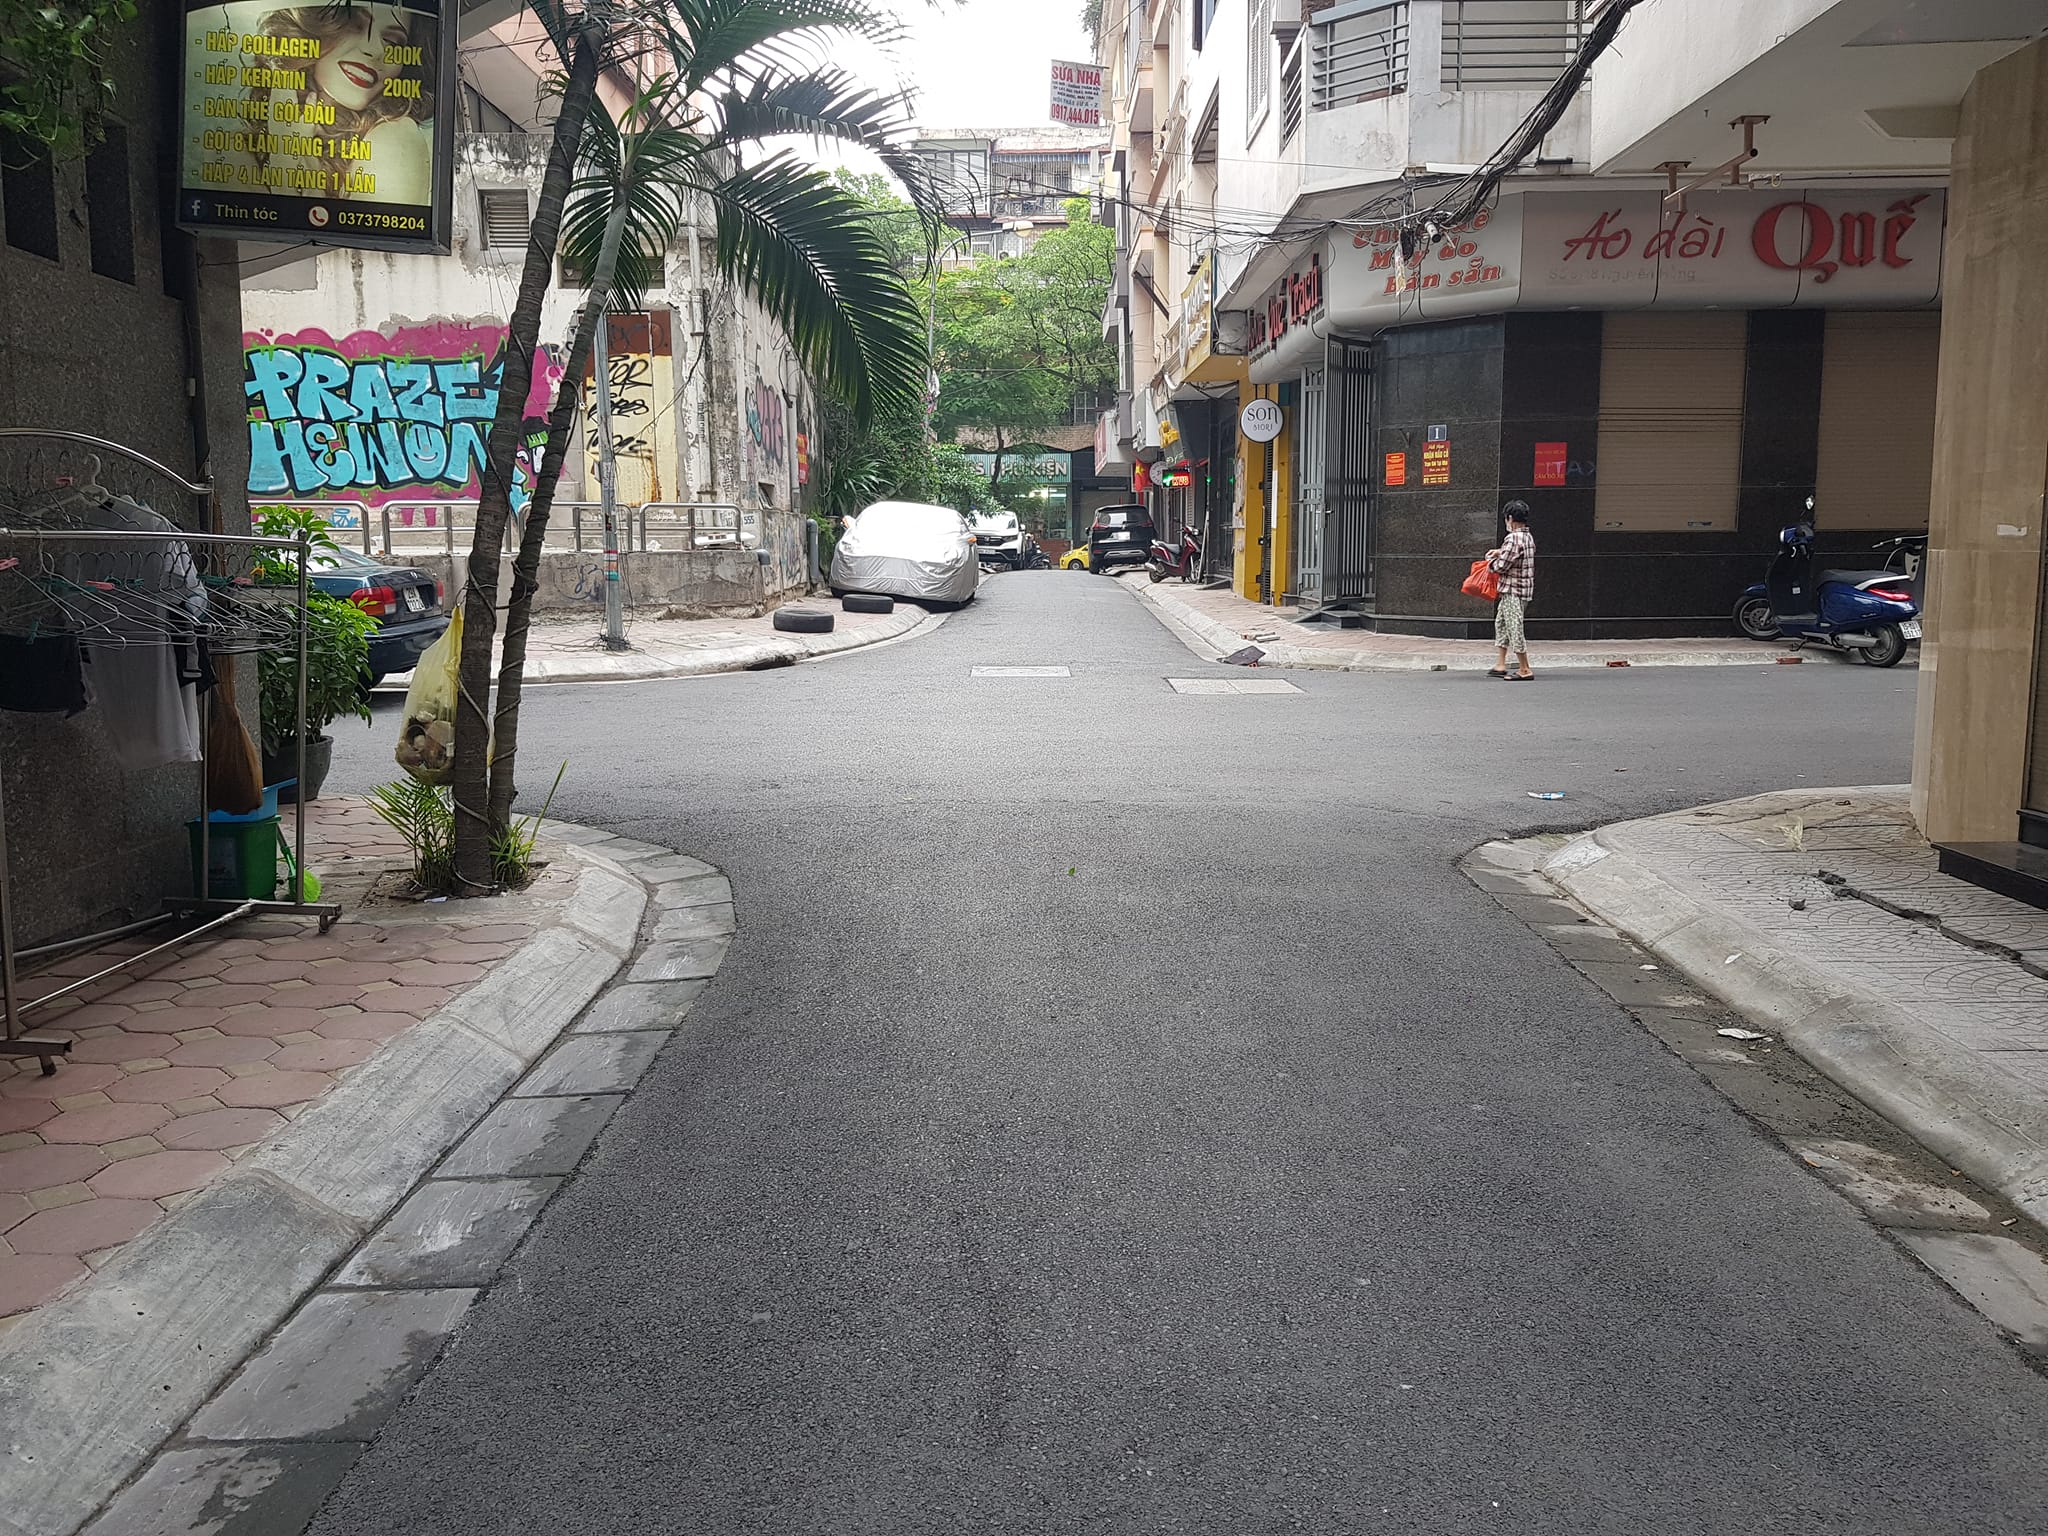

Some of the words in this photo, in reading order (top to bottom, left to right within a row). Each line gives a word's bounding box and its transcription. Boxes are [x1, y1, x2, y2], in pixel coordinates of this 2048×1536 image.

[241, 34, 320, 58] COLLAGEN
[383, 46, 422, 66] 200K
[205, 59, 237, 85] HẤP
[241, 66, 306, 90] KERATIN
[383, 78, 422, 99] 200K
[204, 94, 237, 118] BÁN
[242, 96, 269, 120] THẺ
[273, 98, 300, 127] GỘI
[303, 99, 336, 125] ĐẦU
[204, 127, 229, 154] GỘI
[234, 132, 243, 150] 8
[248, 128, 279, 154] LẦN
[282, 132, 323, 159] TẶNG
[328, 139, 335, 158] 1
[341, 134, 371, 161] LẦN
[202, 157, 234, 183] HẤP
[238, 167, 248, 184] 4
[252, 160, 282, 187] LẦN
[286, 165, 327, 192] TẶNG
[332, 173, 339, 190] 1
[215, 203, 249, 219] Thìn
[253, 207, 279, 221] tóc
[338, 211, 426, 230] 0373798204
[1563, 208, 1632, 261] Áo
[1643, 209, 1725, 260] dài
[1751, 194, 1931, 284] Quế
[1369, 249, 1427, 271] My
[1447, 256, 1500, 286] sẵn
[245, 349, 501, 425] PRAZE
[1434, 427, 1439, 439] 1
[1030, 457, 1067, 480] KIỆN
